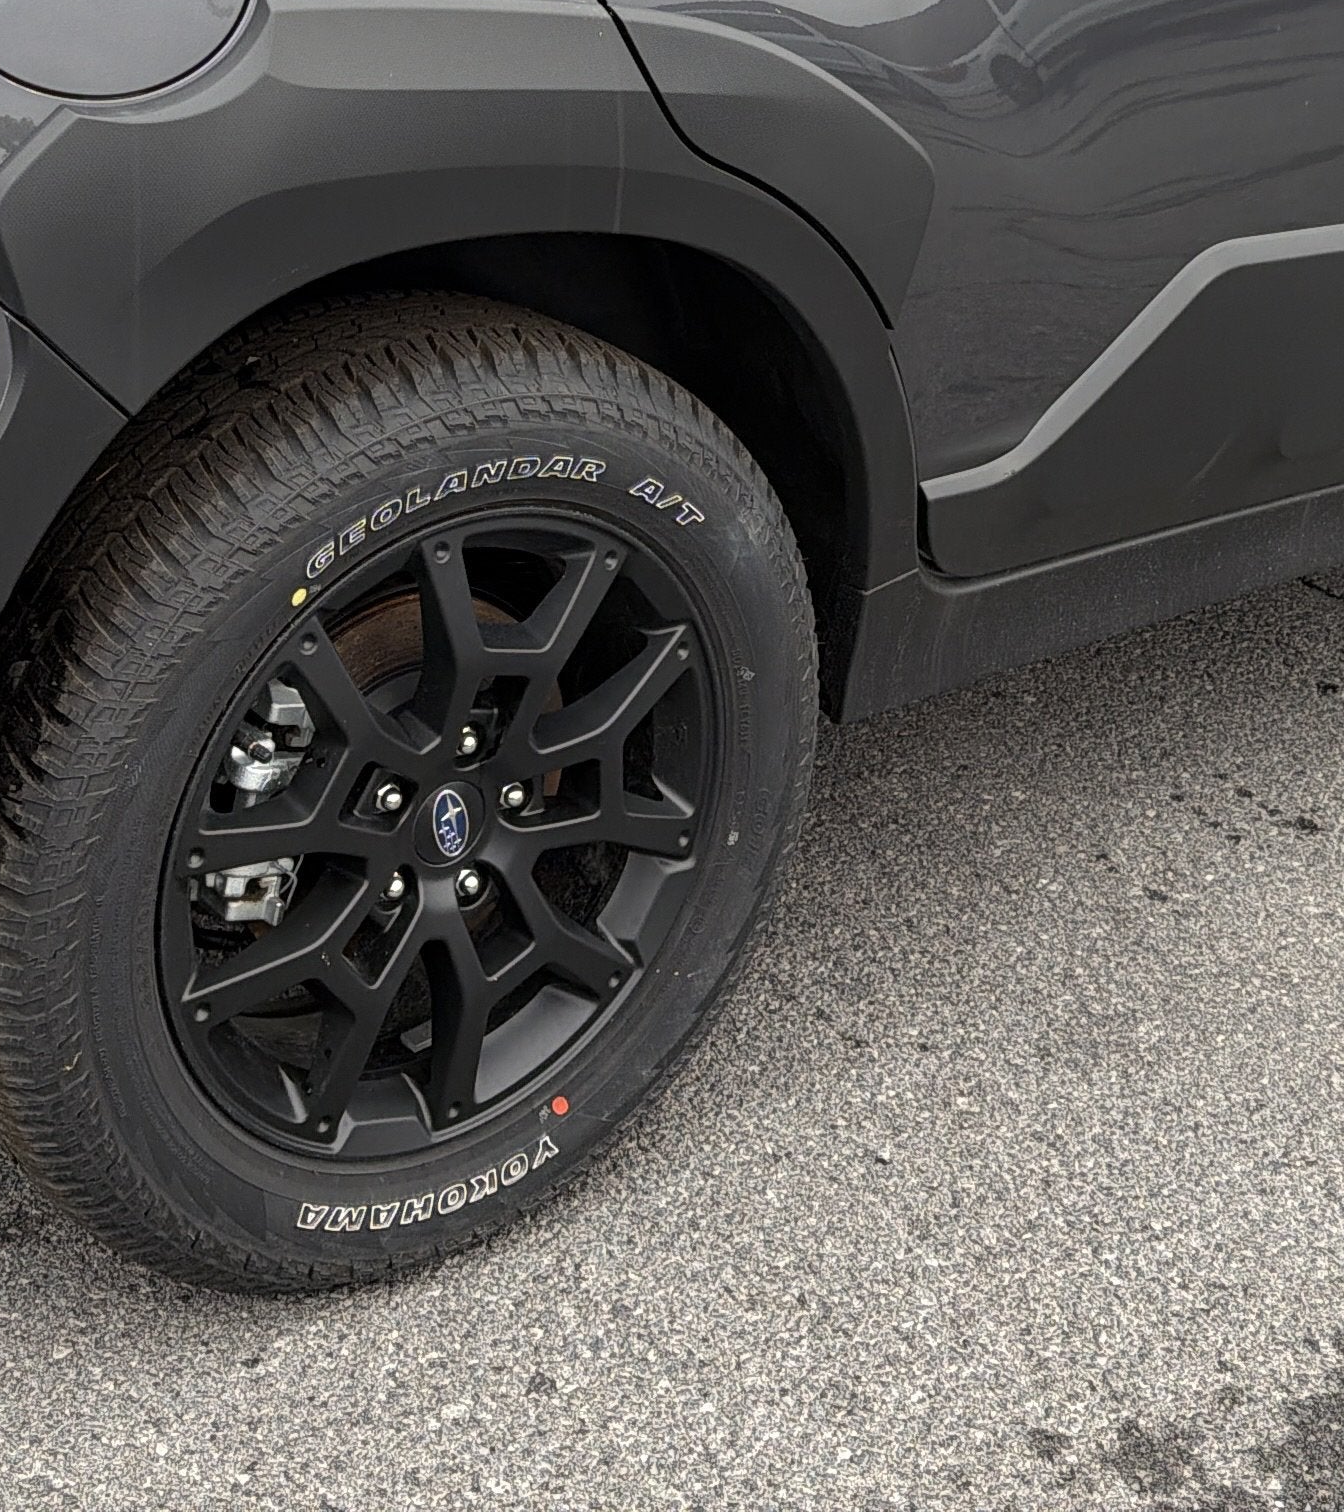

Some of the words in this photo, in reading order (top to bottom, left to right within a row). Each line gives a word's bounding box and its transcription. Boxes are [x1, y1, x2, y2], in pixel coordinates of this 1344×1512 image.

[305, 455, 606, 580] GEOLANDAR
[628, 476, 705, 527] A/T
[296, 1135, 560, 1232] YOKOHAMA
